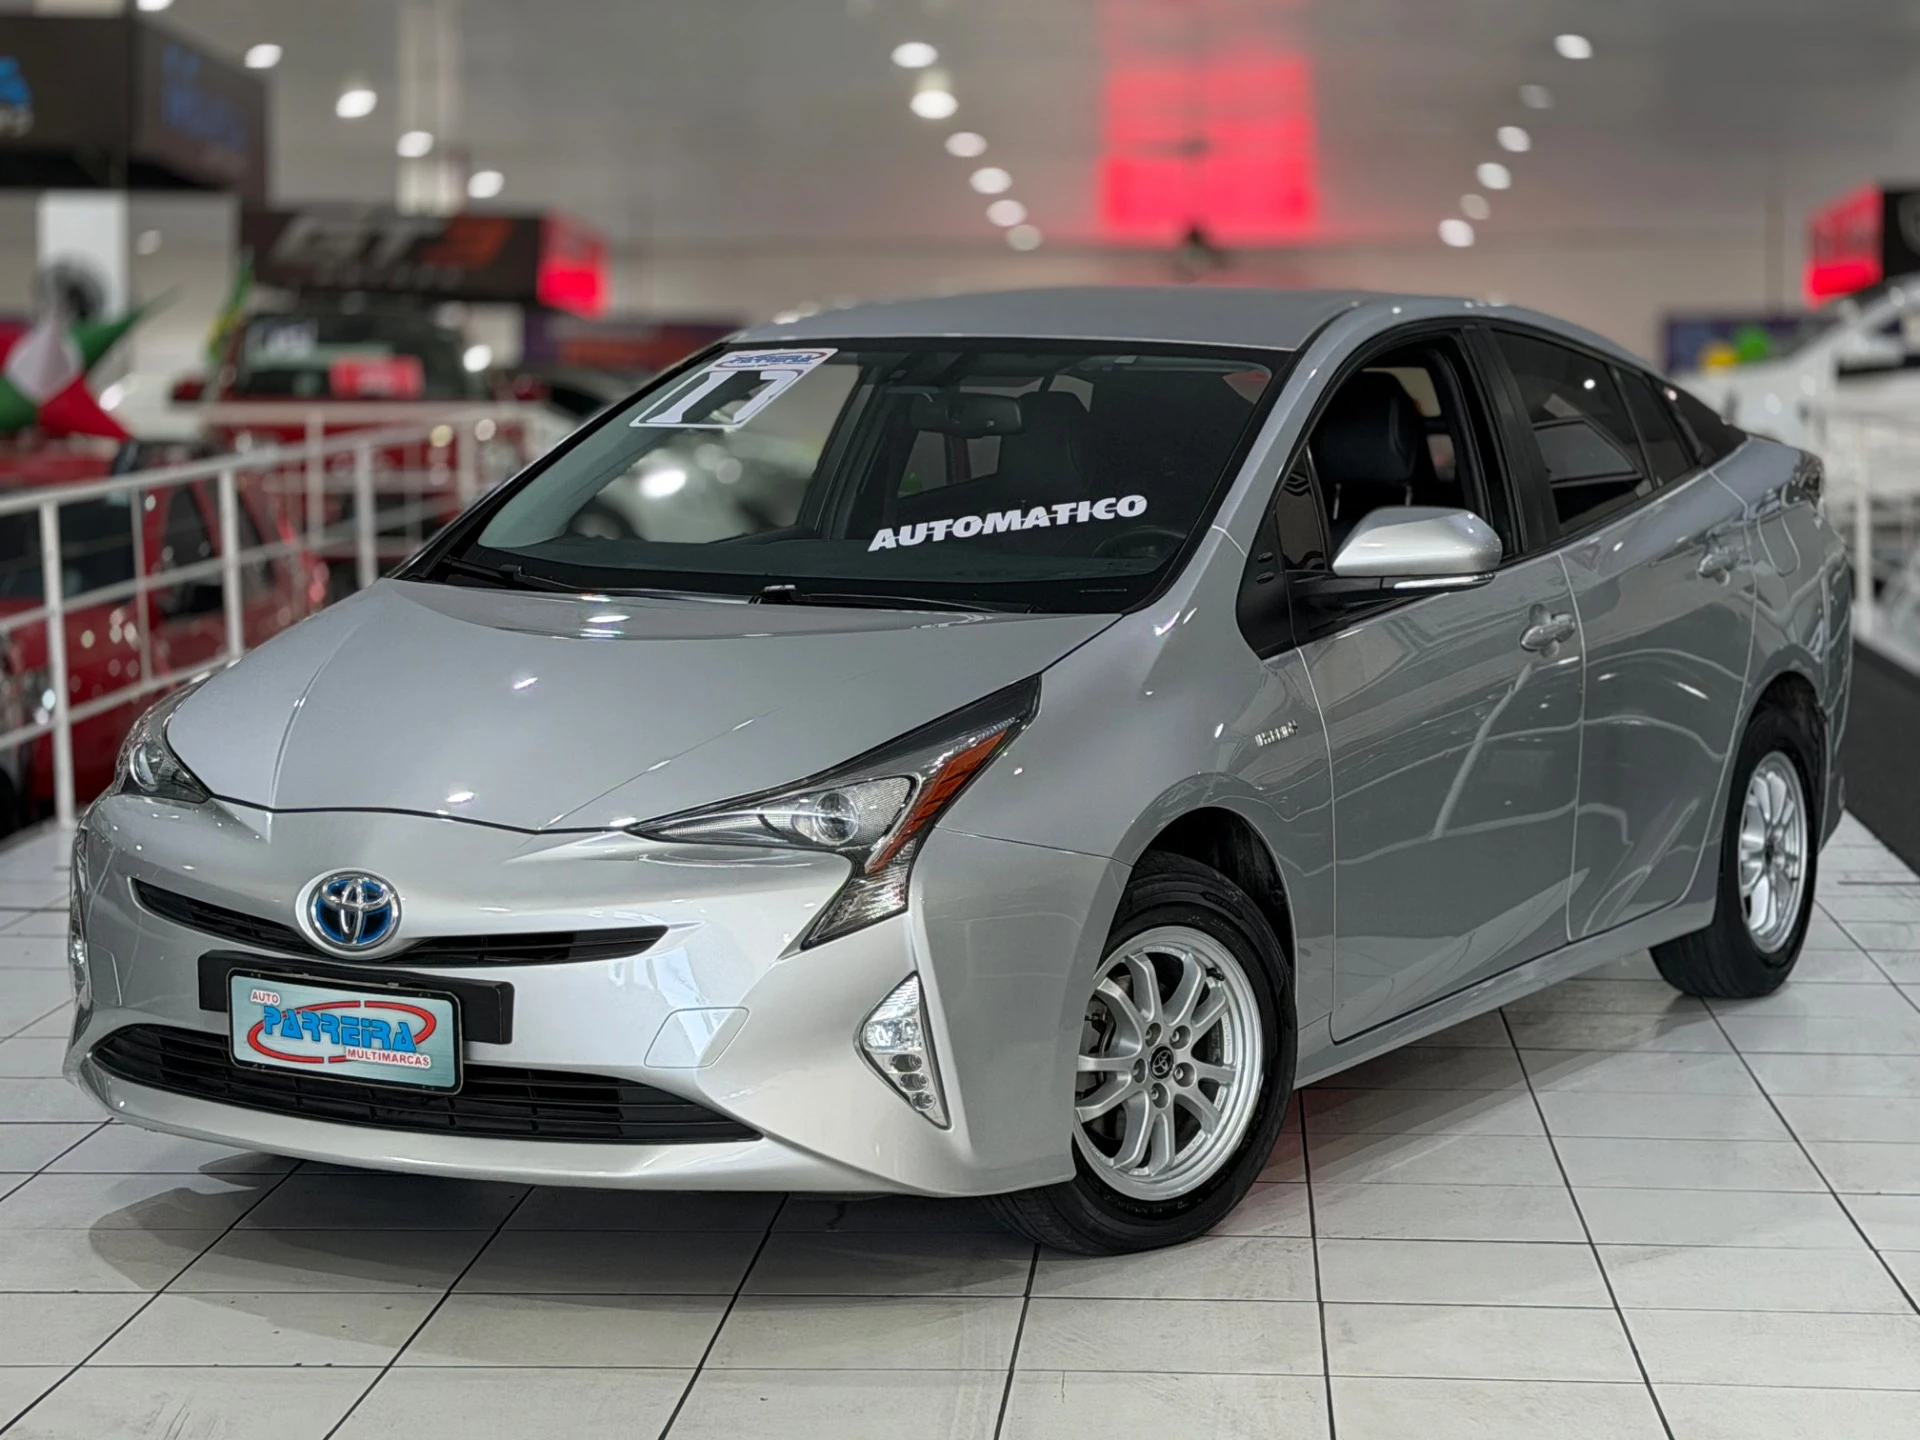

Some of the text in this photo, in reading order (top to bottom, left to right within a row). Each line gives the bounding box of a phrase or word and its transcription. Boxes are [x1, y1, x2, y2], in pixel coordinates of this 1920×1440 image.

[646, 370, 801, 424] 17
[868, 495, 1148, 552] AUTOMATICO
[252, 991, 279, 1004] AUTO
[264, 1005, 417, 1053] PARREIRA
[347, 1049, 430, 1066] MULTIMARCAS
